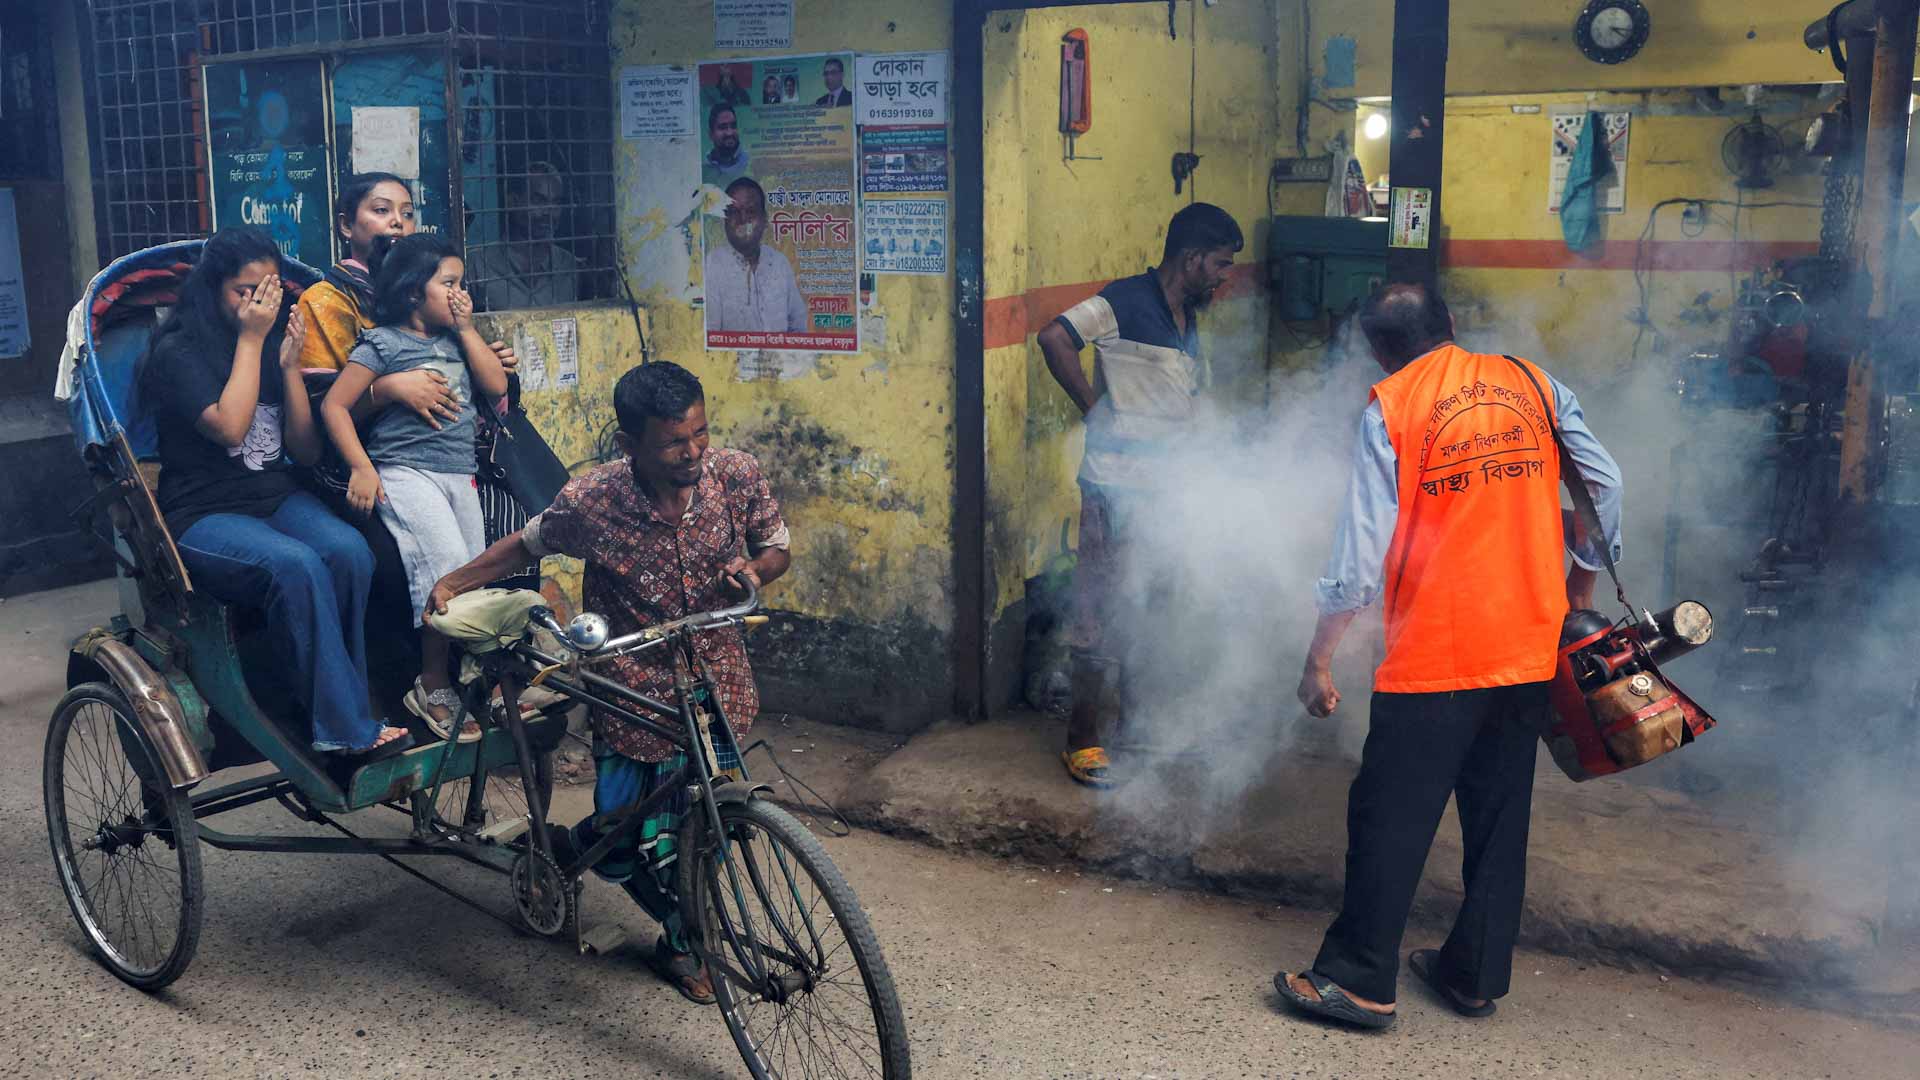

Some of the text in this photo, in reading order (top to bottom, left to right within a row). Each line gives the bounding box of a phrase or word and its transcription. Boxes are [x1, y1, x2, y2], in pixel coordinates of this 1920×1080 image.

[872, 59, 925, 76] দোকান
[864, 80, 938, 100] ভাড়া হবে
[869, 109, 934, 118] 01639193169
[230, 169, 244, 182] যিনি
[1431, 394, 1462, 424] দক্ষিণ
[1461, 380, 1488, 402] সিটি
[1440, 440, 1470, 459] মশক
[1475, 433, 1500, 452] নিধন
[1421, 460, 1545, 496] স্বাস্থ্য বিভাগ
